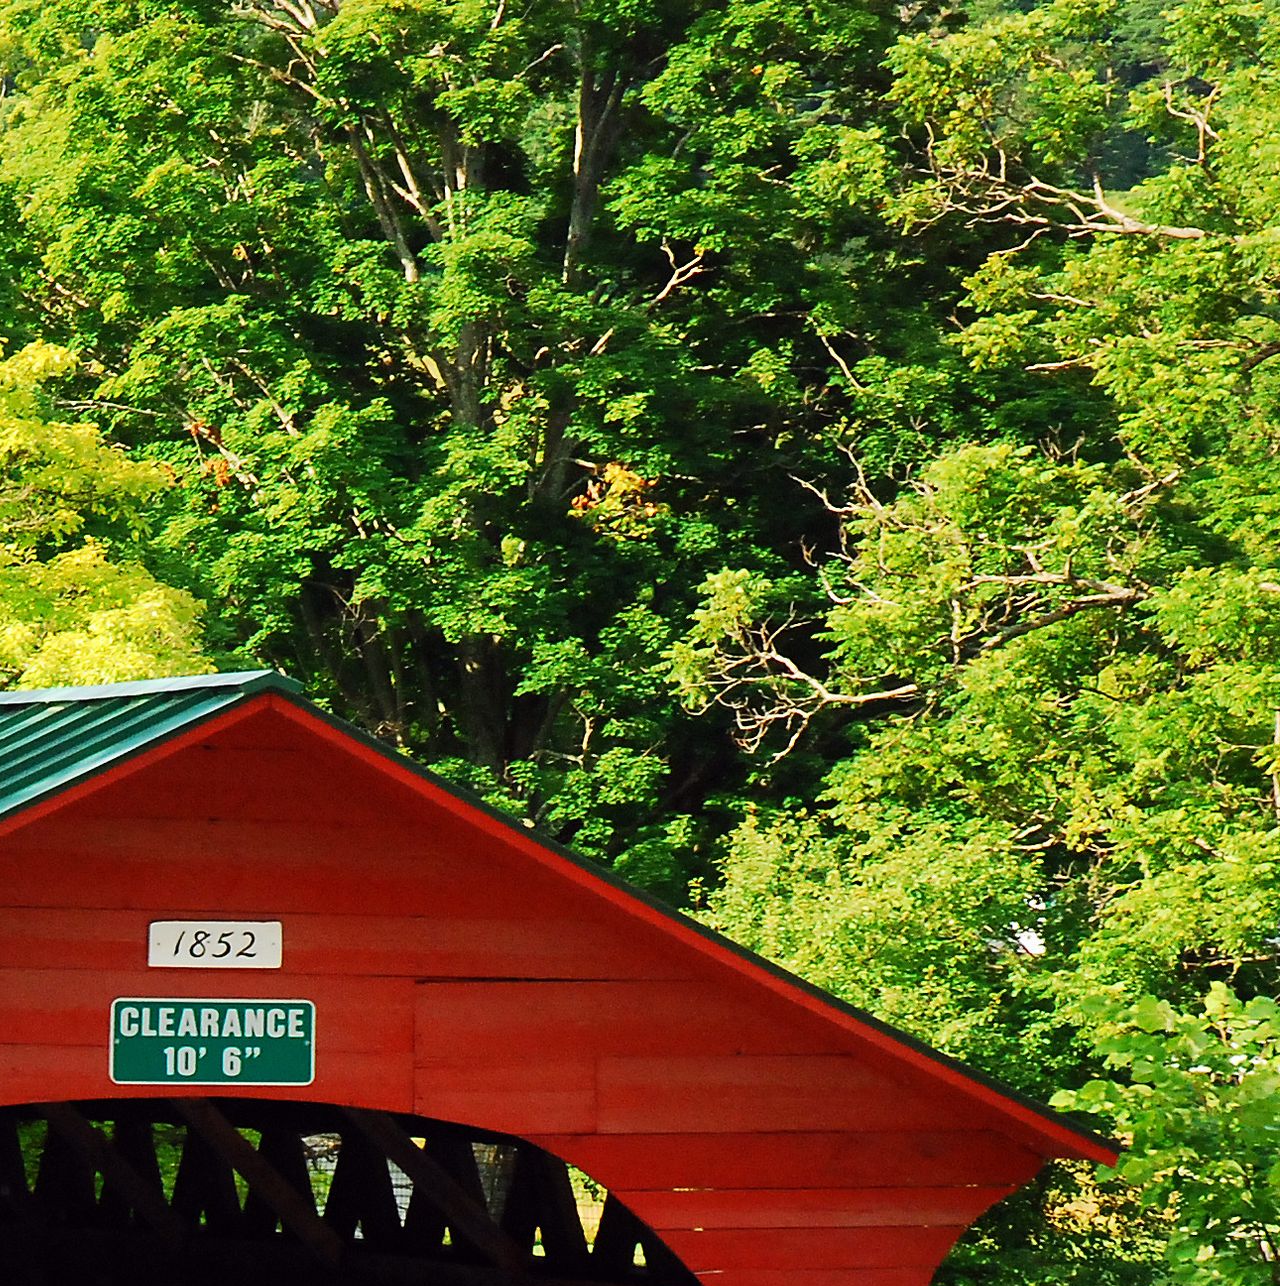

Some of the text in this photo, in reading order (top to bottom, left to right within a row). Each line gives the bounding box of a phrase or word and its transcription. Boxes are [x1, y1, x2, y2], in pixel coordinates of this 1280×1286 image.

[174, 930, 257, 958] 1852
[120, 1007, 305, 1038] CLEARANCE
[163, 1046, 261, 1077] 10' 6"
